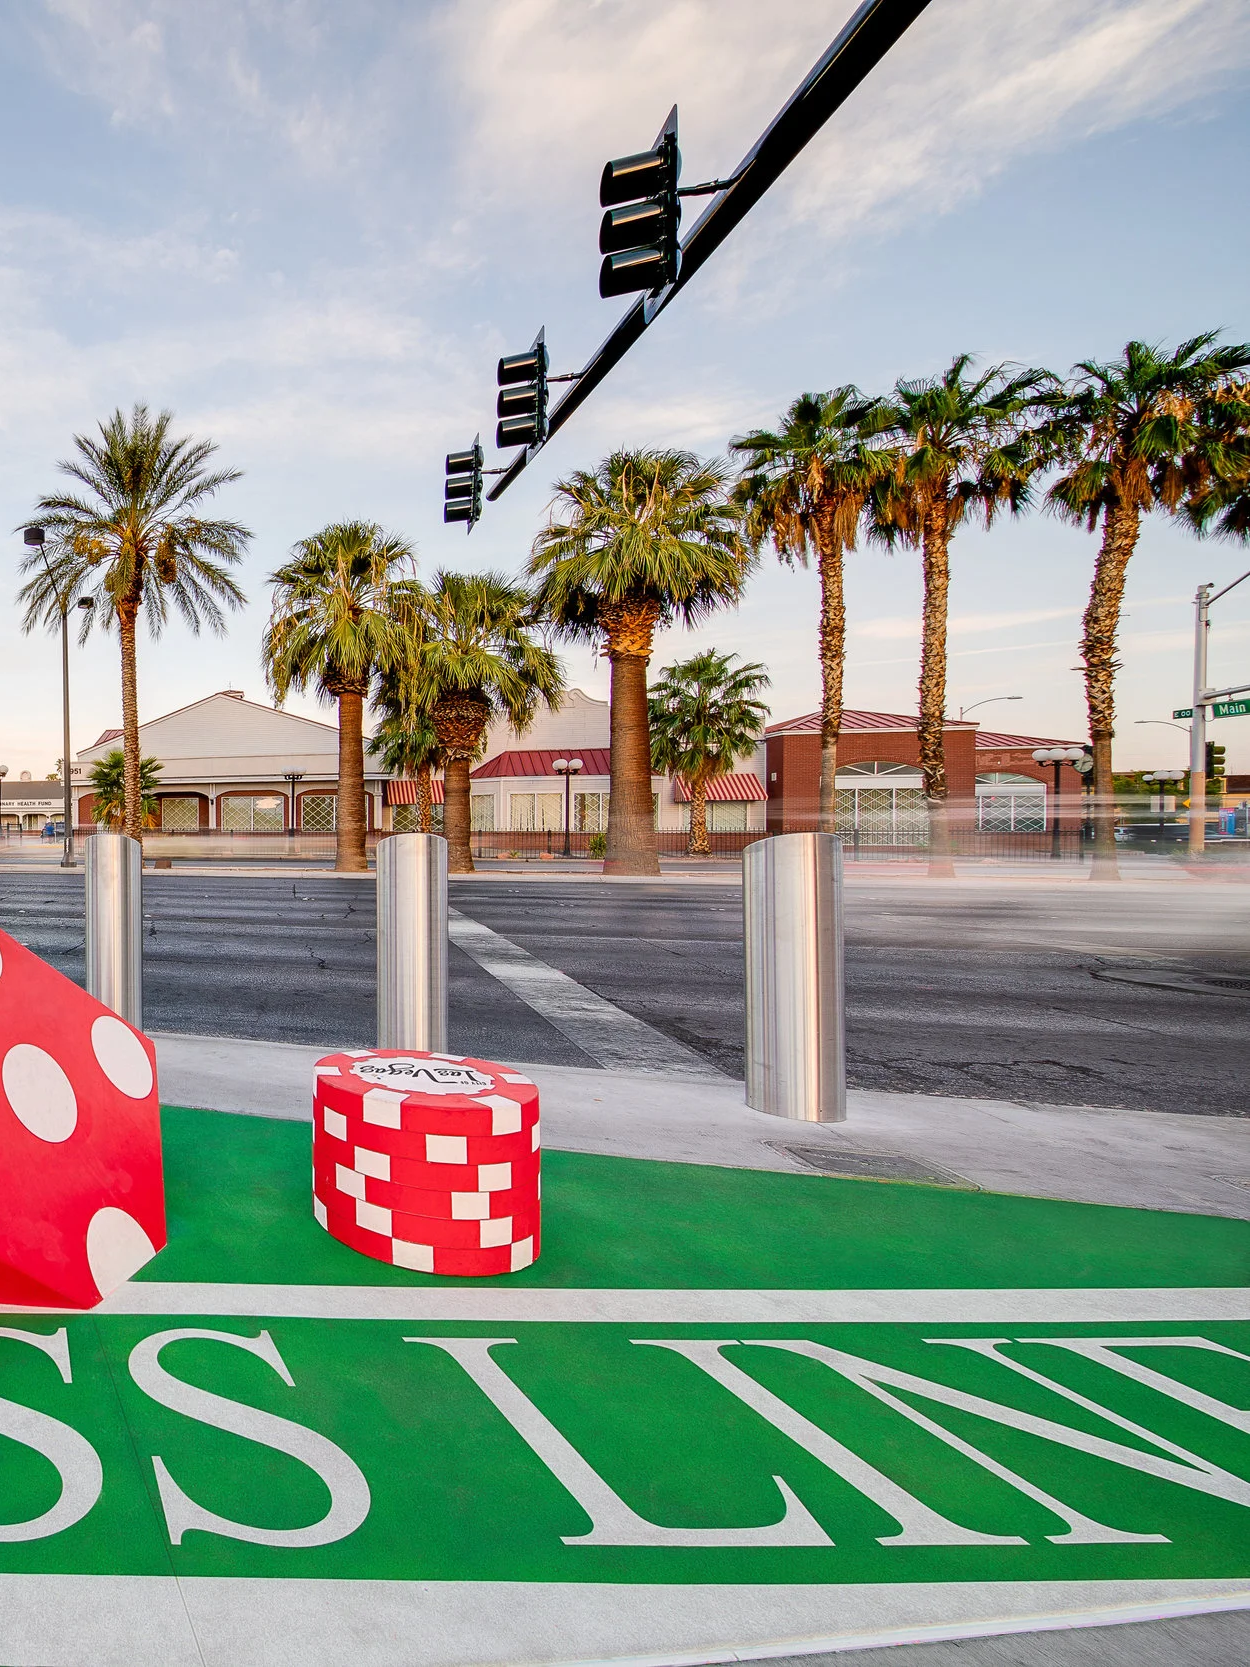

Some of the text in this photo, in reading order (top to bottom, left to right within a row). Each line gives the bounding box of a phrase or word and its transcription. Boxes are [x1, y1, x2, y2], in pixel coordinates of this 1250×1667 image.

[1218, 703, 1246, 715] Main
[359, 1063, 478, 1083] Las Vegas
